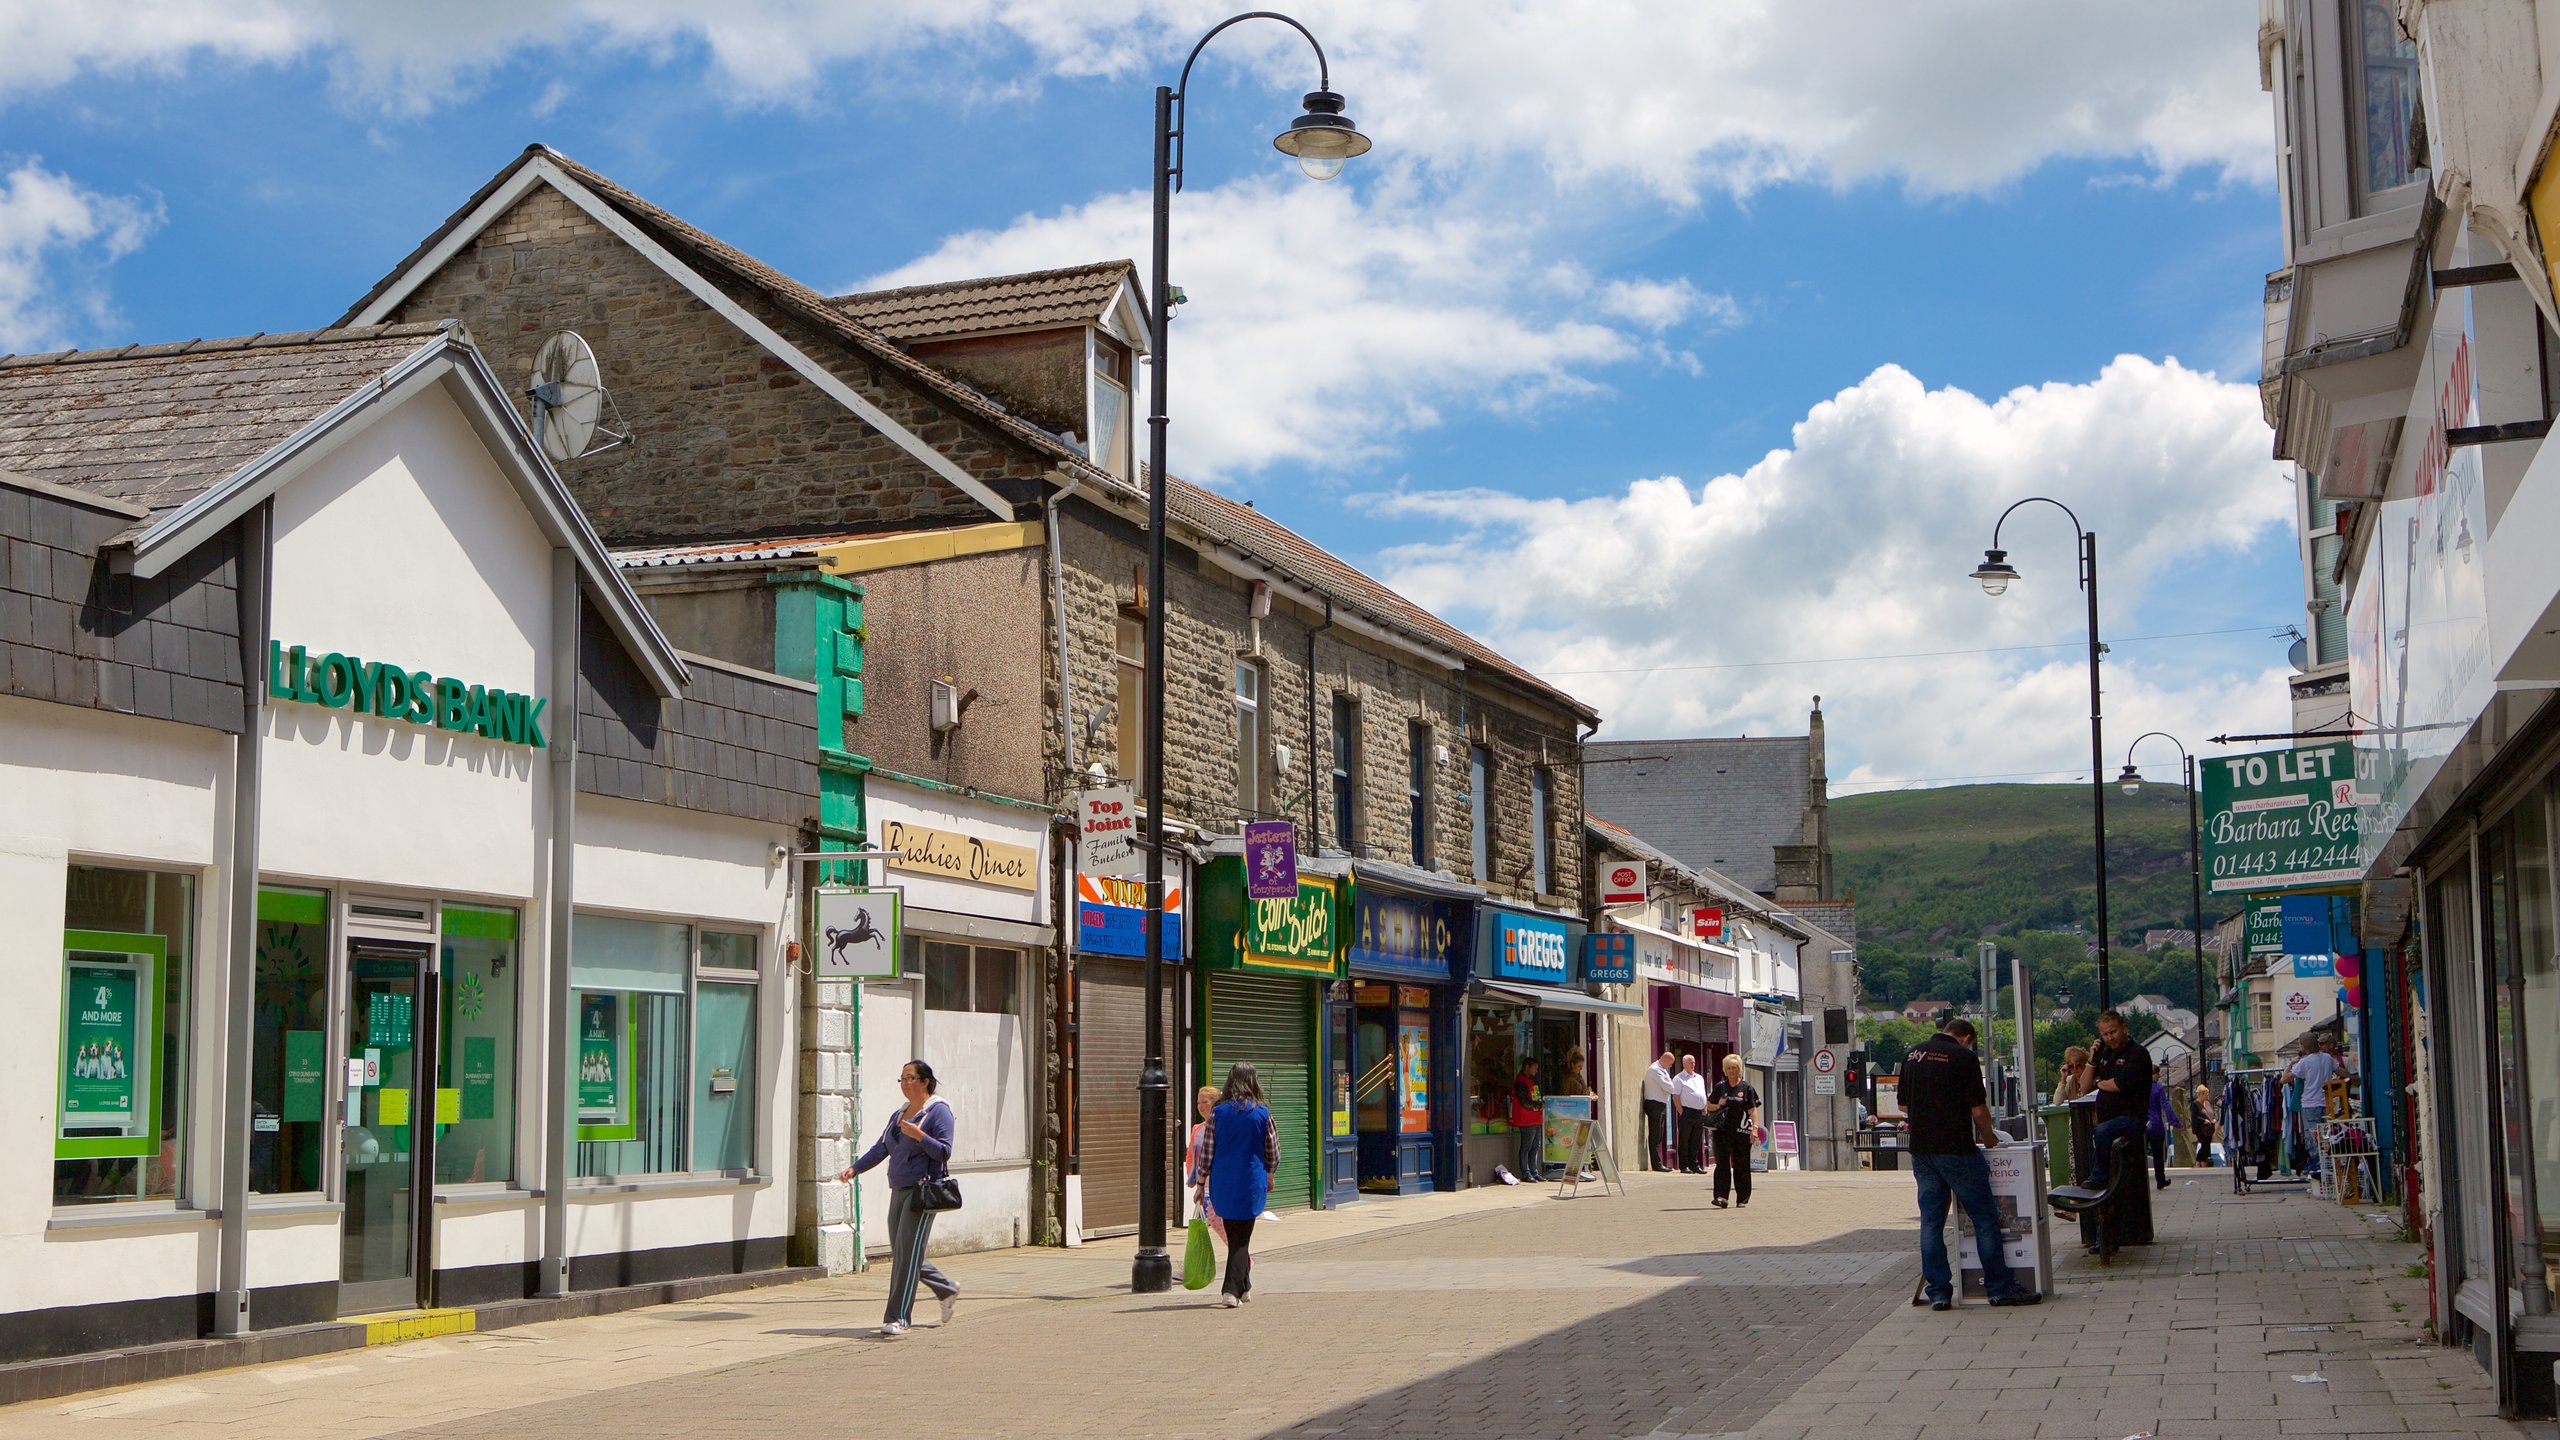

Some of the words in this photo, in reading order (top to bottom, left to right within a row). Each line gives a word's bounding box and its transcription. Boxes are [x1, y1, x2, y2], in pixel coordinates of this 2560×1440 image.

[269, 639, 435, 725] LLOYDS
[436, 676, 548, 749] BANK
[2225, 756, 2268, 788] TO
[2277, 748, 2336, 783] LET
[1088, 800, 1124, 815] Top
[1084, 816, 1132, 833] Joint
[2211, 810, 2302, 845] Barbara
[2308, 800, 2359, 841] Rees
[1247, 829, 1292, 845] Jesters
[887, 821, 961, 871] Richies
[968, 836, 1027, 881] Diner
[1088, 849, 1135, 867] Butchers
[2213, 850, 2278, 877] 01443
[2284, 844, 2360, 871] 442444
[1268, 876, 1278, 885] of
[1101, 877, 1147, 907] SUNRI
[1287, 892, 1328, 955] Dutch
[1361, 904, 1446, 953] ASHINO
[1696, 918, 1720, 927] Sun
[1518, 928, 1565, 970] GREGGS
[1590, 969, 1629, 979] GREGGS
[81, 1010, 99, 1022] AND
[100, 1011, 122, 1023] MORE
[1907, 1049, 1928, 1063] sky
[1992, 1157, 2013, 1168] Sky
